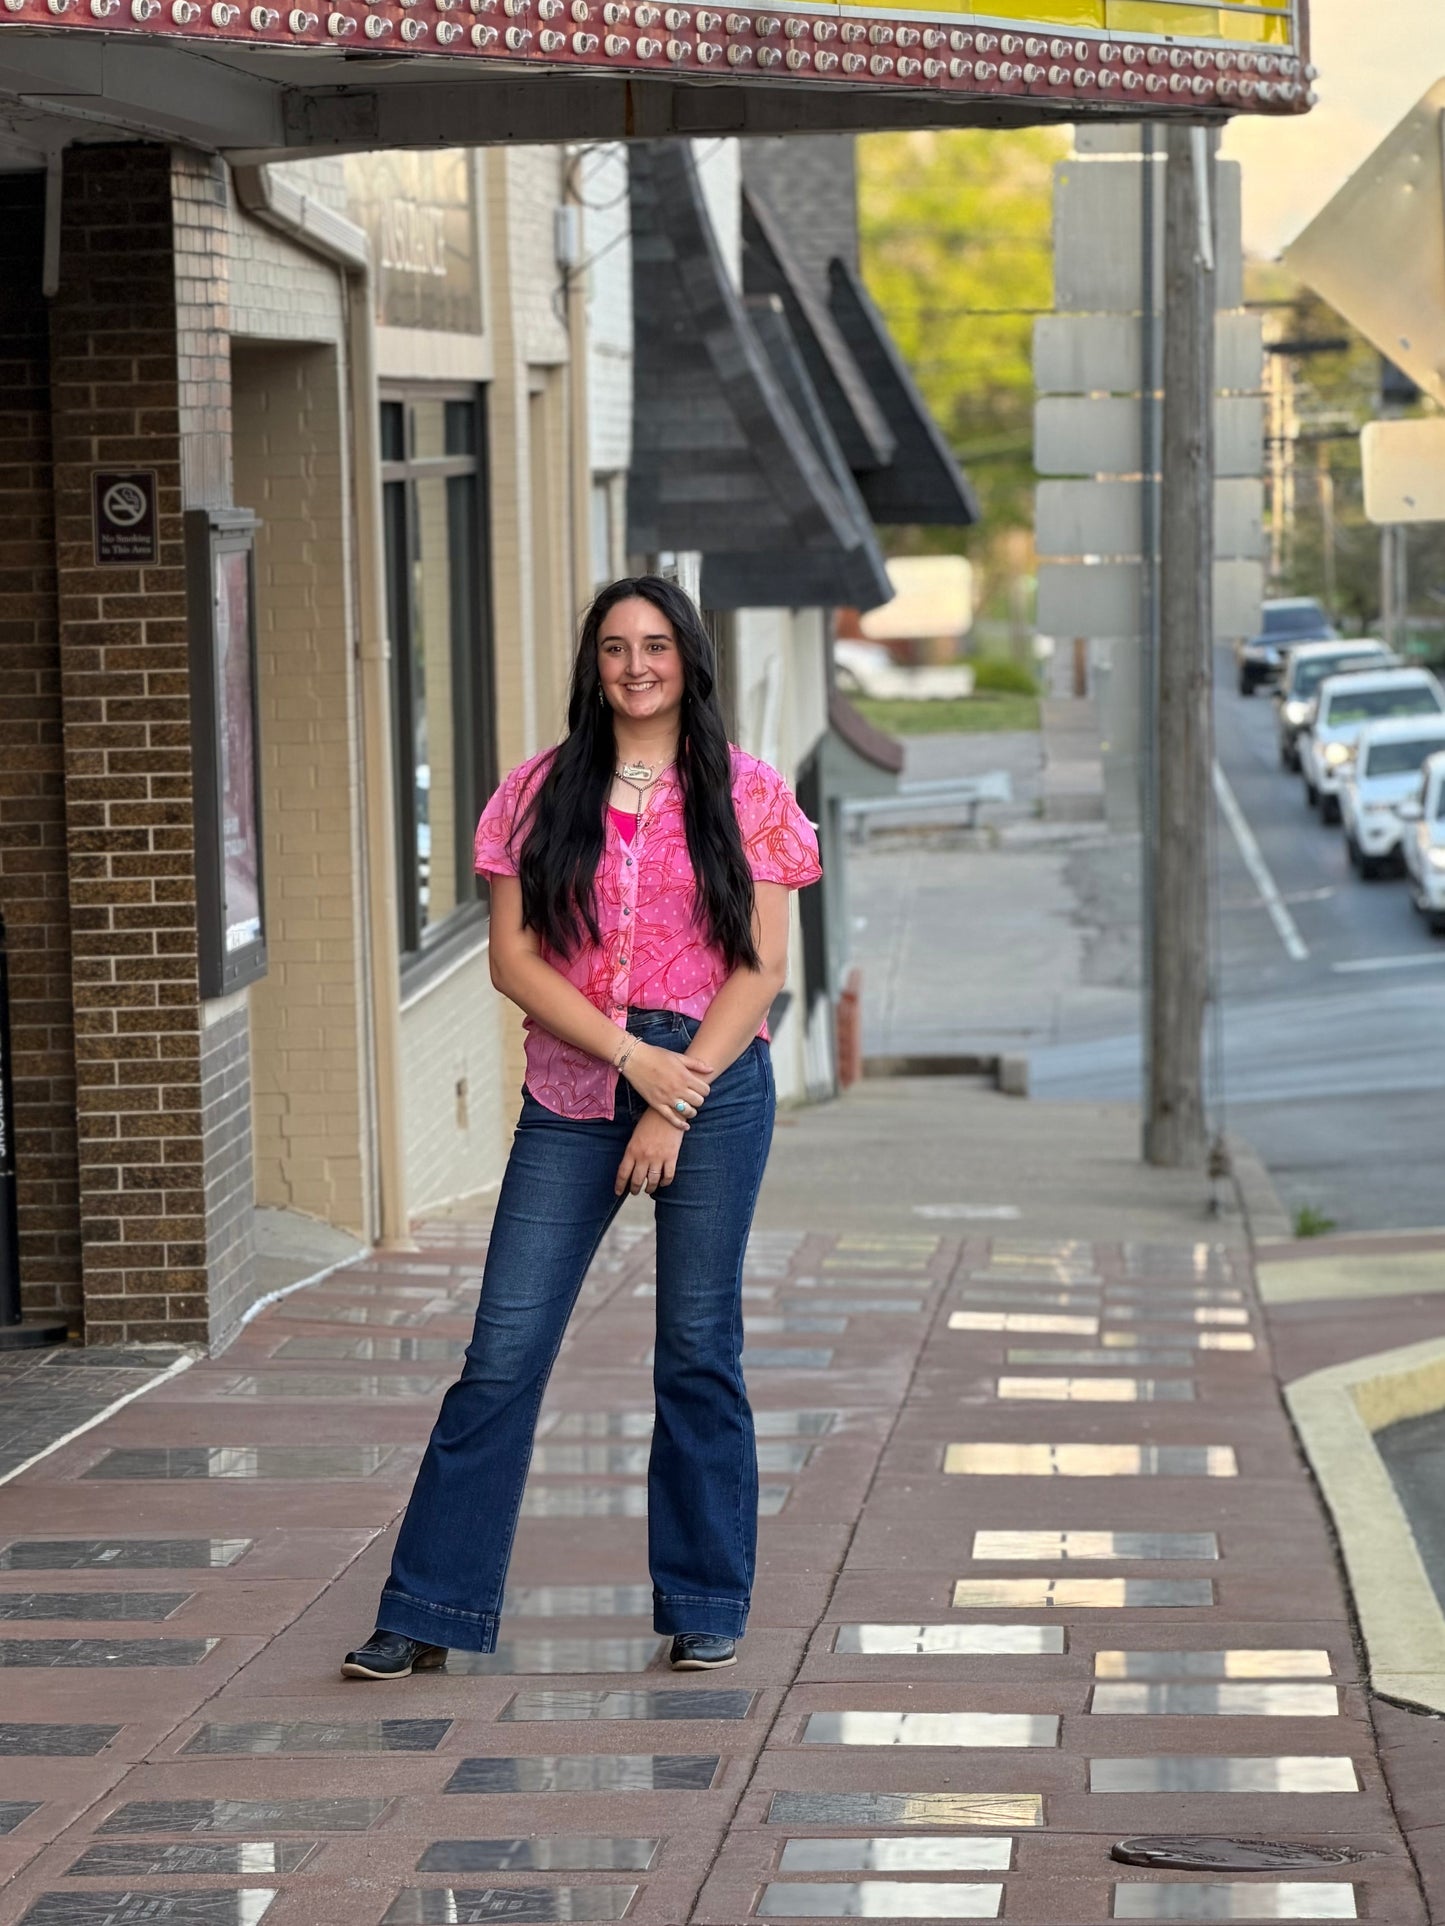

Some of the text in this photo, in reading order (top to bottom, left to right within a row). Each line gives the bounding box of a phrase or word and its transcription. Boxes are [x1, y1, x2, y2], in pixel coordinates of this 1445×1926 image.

[102, 533, 151, 544] No Smoking
[112, 545, 130, 554] This
[132, 545, 152, 554] Area
